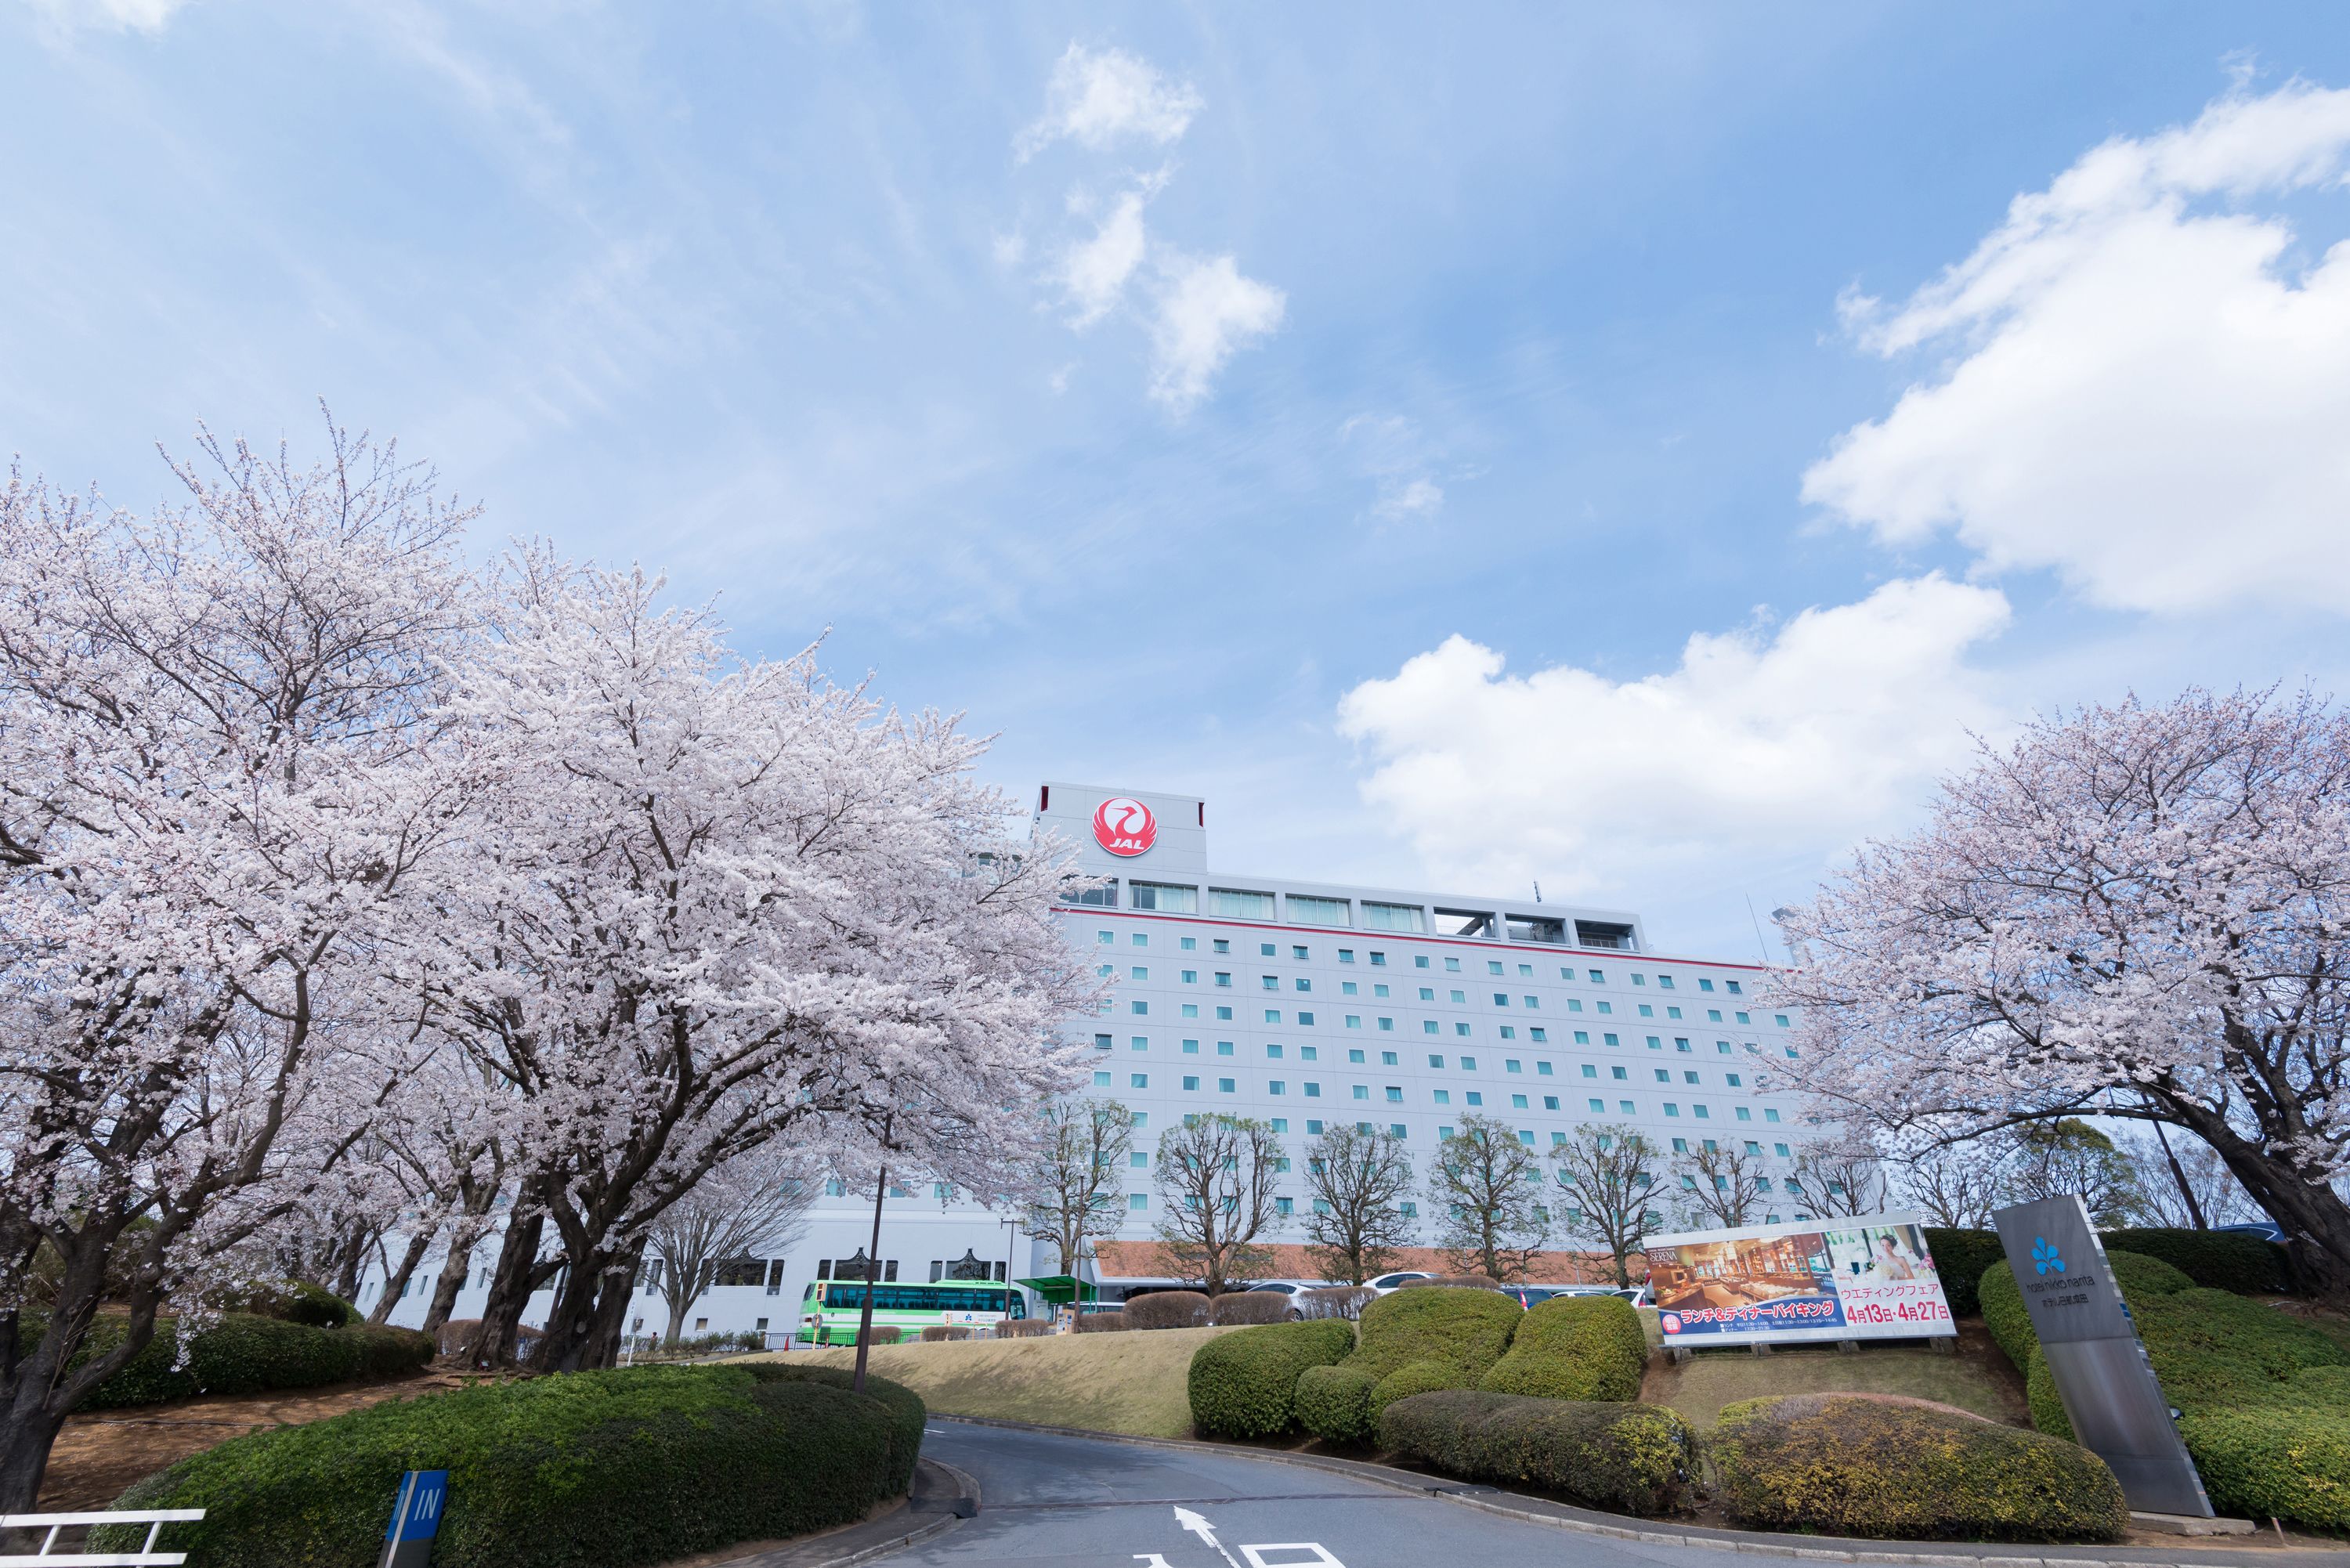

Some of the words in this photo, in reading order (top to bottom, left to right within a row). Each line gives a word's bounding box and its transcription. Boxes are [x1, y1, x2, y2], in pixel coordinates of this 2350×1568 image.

[1109, 837, 1144, 850] JAL
[1650, 1251, 1678, 1262] SERENA
[1841, 1284, 1939, 1299] ウエディングフェア
[2026, 1281, 2045, 1293] hotel
[2045, 1278, 2067, 1290] nikko
[2067, 1275, 2095, 1288] narita
[414, 1488, 440, 1521] IN
